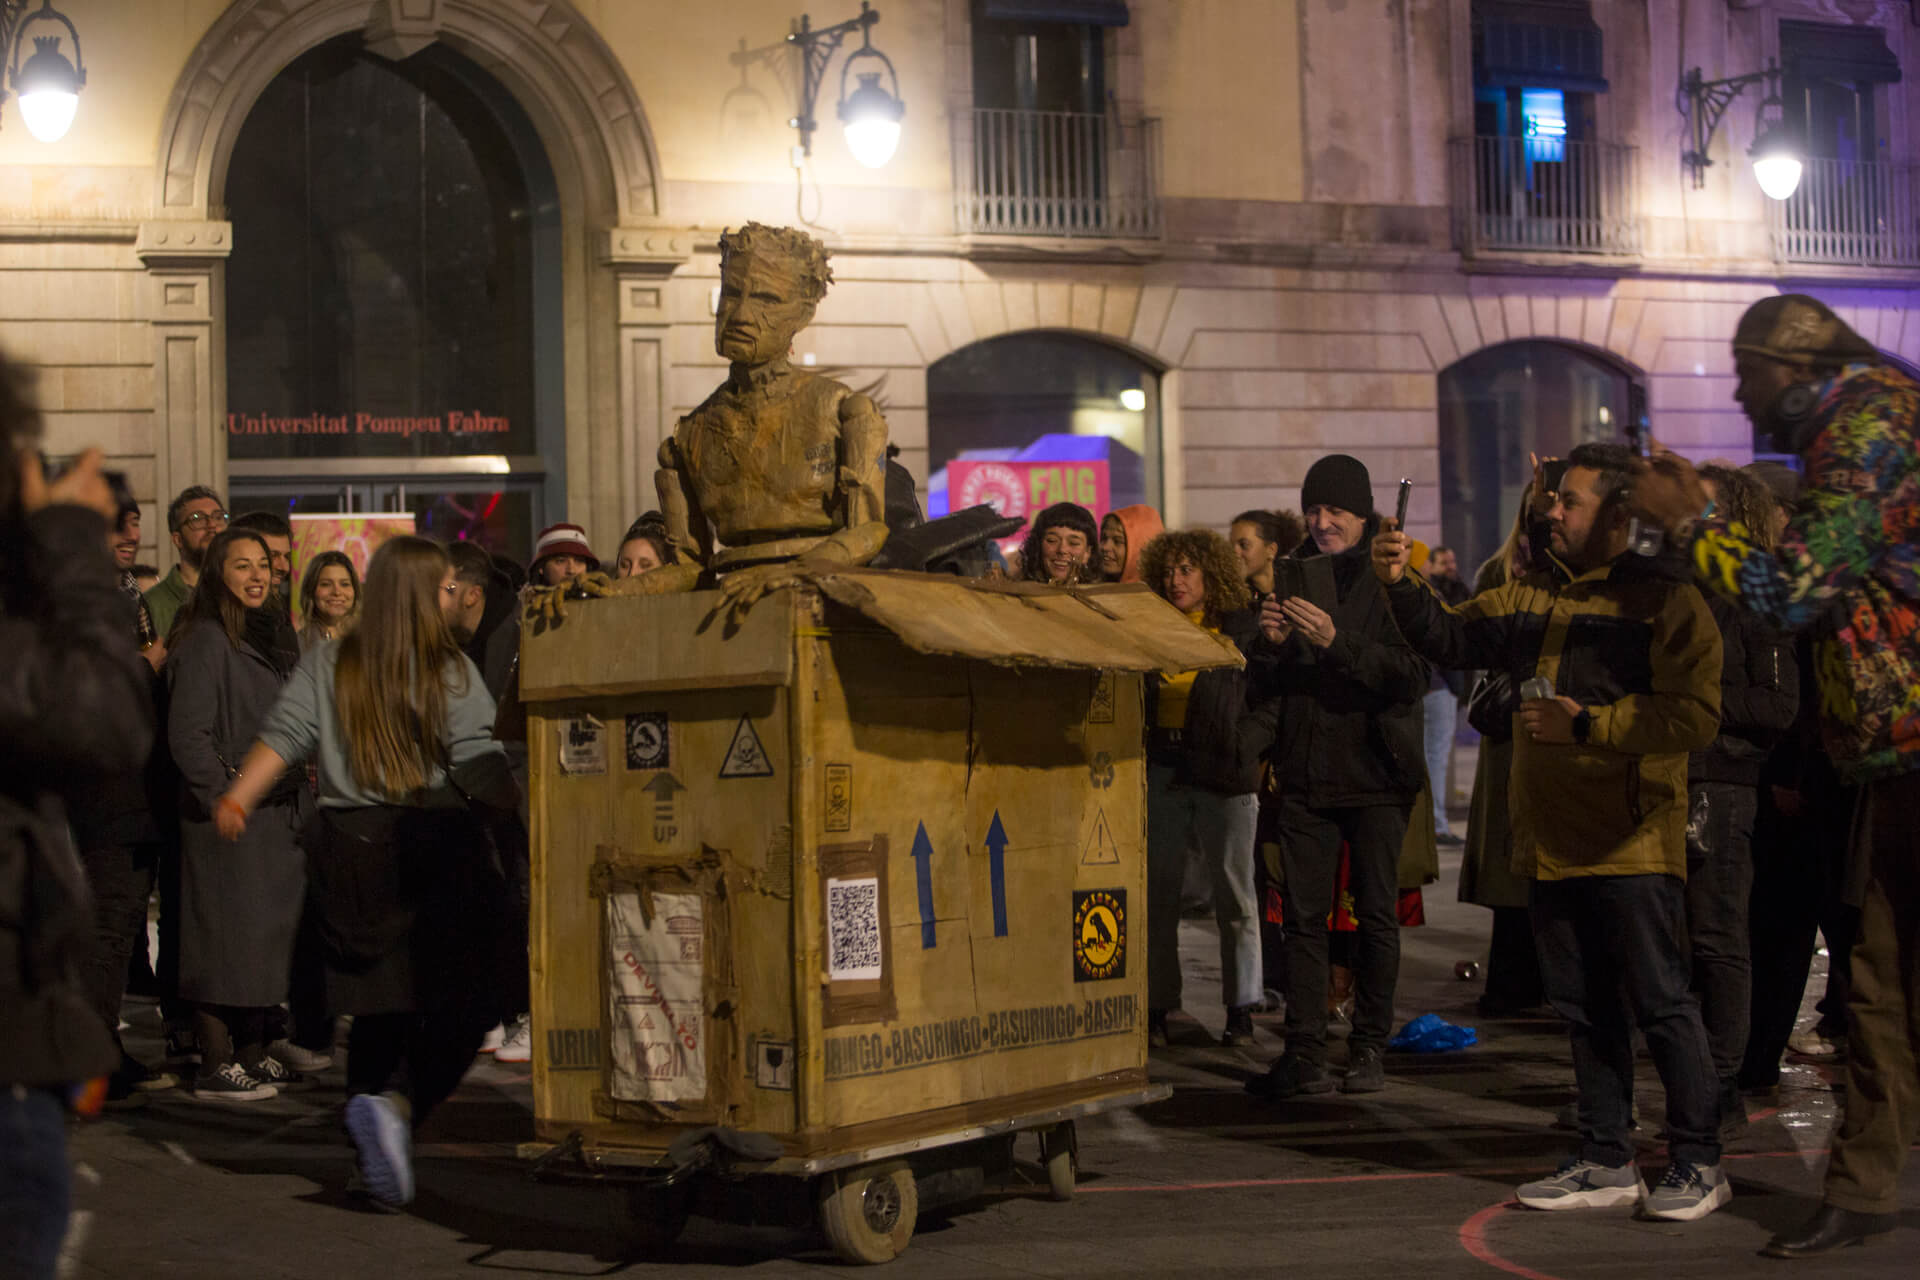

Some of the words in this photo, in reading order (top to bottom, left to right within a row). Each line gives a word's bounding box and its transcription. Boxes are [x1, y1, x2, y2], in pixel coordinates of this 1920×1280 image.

[228, 413, 348, 434] Universitat
[355, 412, 441, 438] Pompeu
[448, 410, 510, 433] Fabra
[1029, 468, 1097, 506] FAIG
[654, 825, 678, 843] UP
